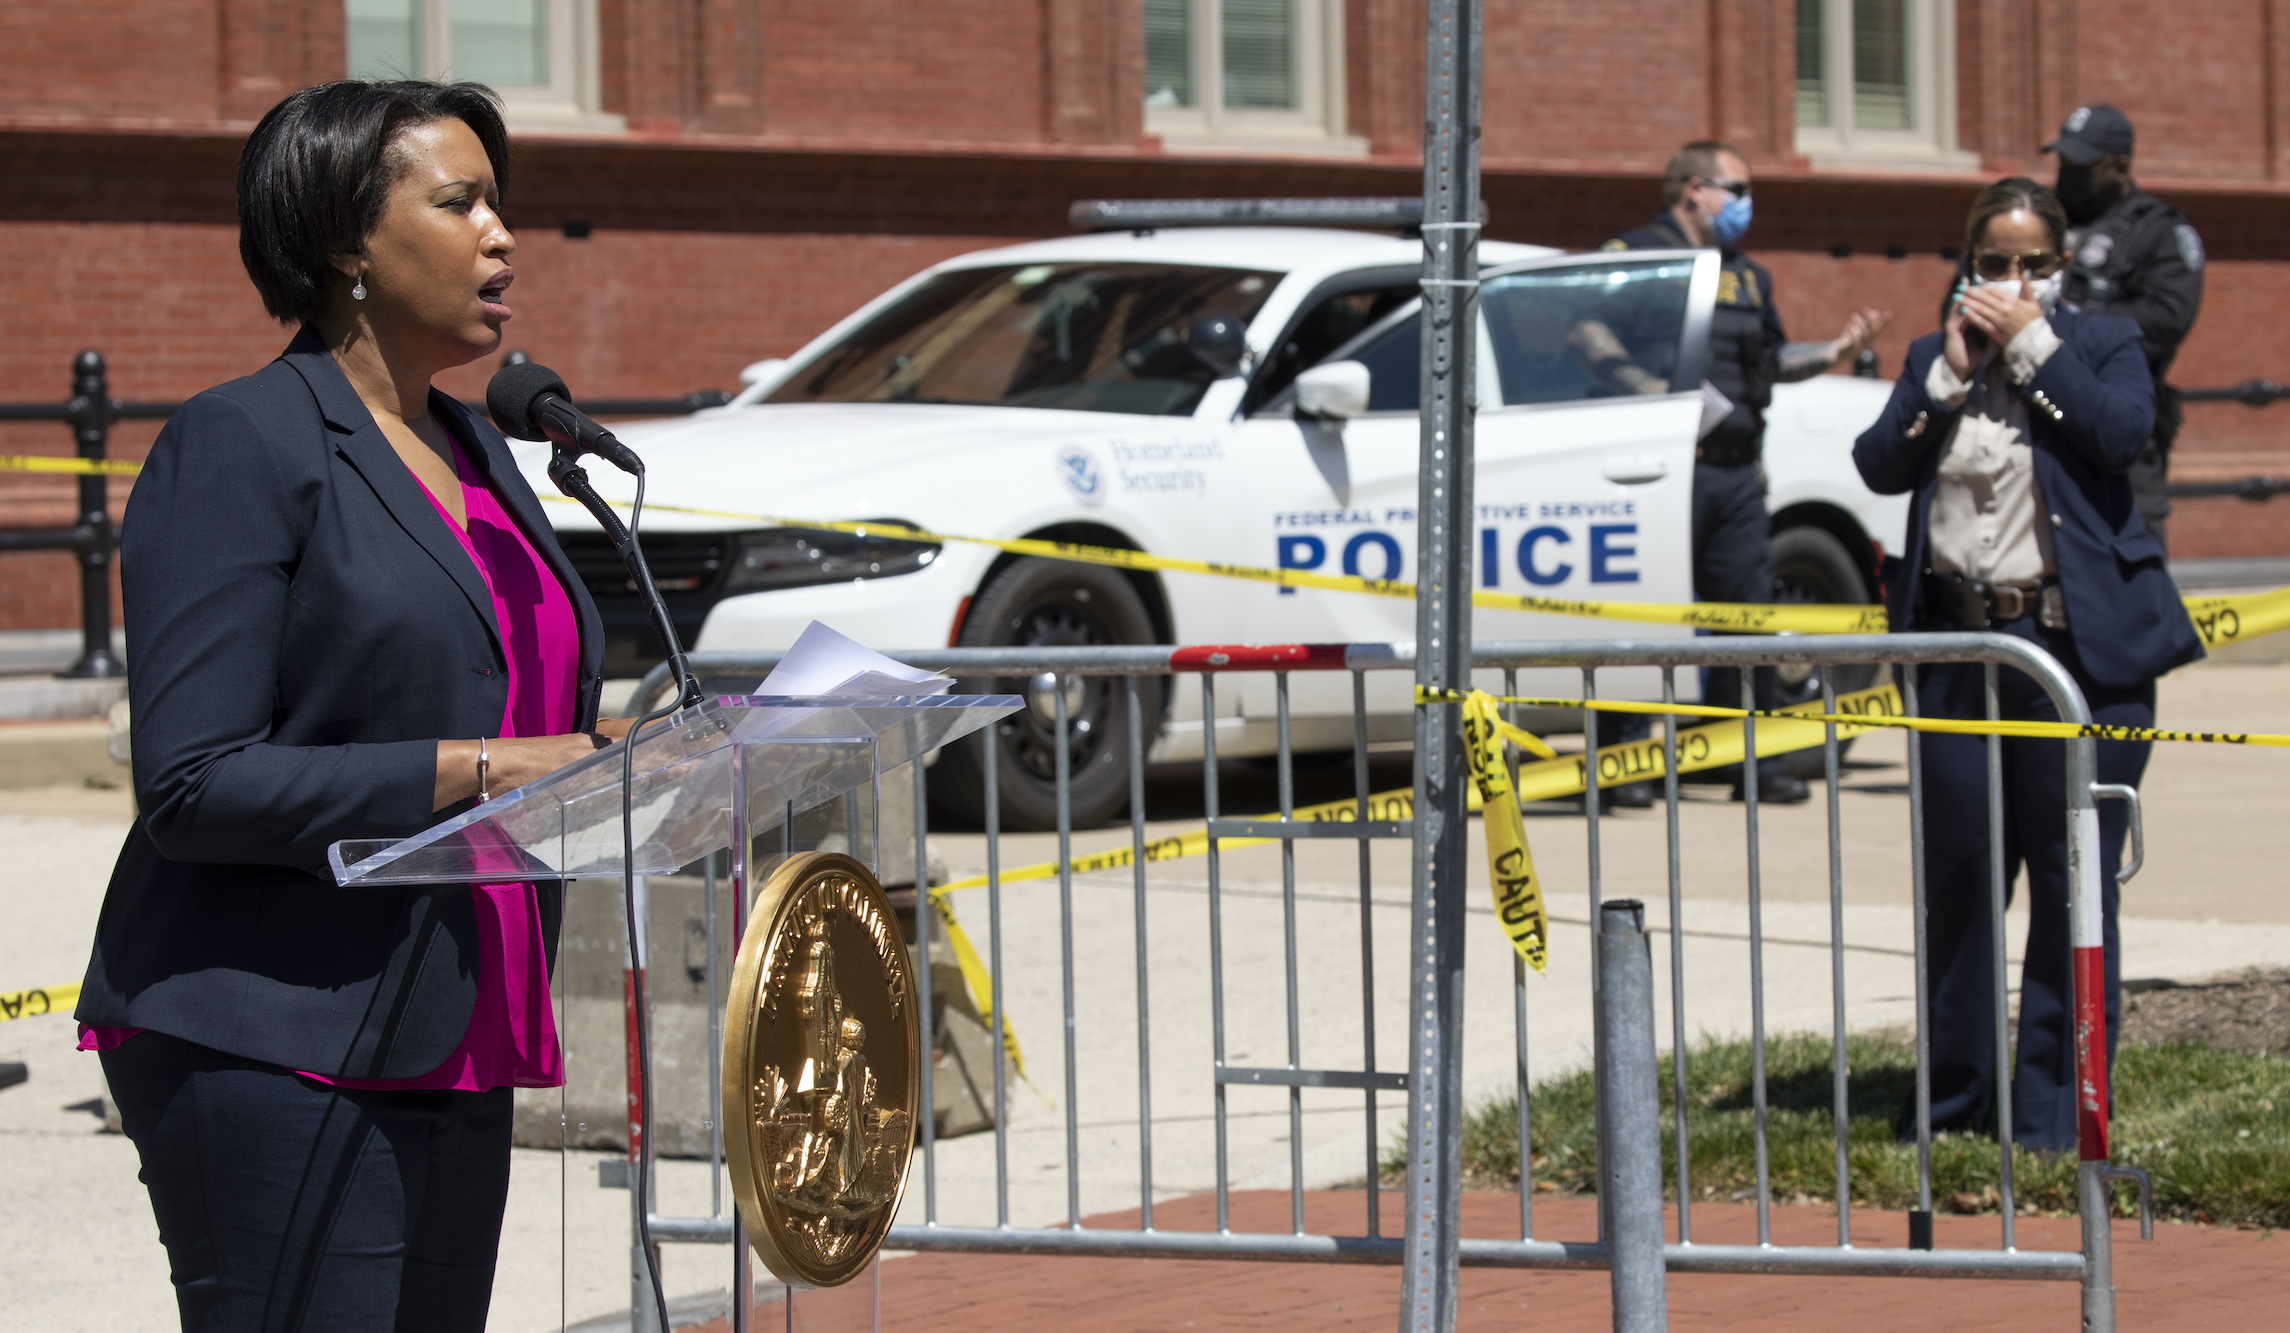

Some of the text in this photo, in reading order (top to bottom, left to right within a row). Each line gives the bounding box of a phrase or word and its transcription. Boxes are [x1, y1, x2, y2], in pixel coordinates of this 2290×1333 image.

[1108, 434, 1226, 461] Homeland
[1119, 465, 1207, 498] Security
[1275, 501, 1637, 527] FEDERAL PRTIVE SERVICE
[1277, 524, 1640, 595] POICE
